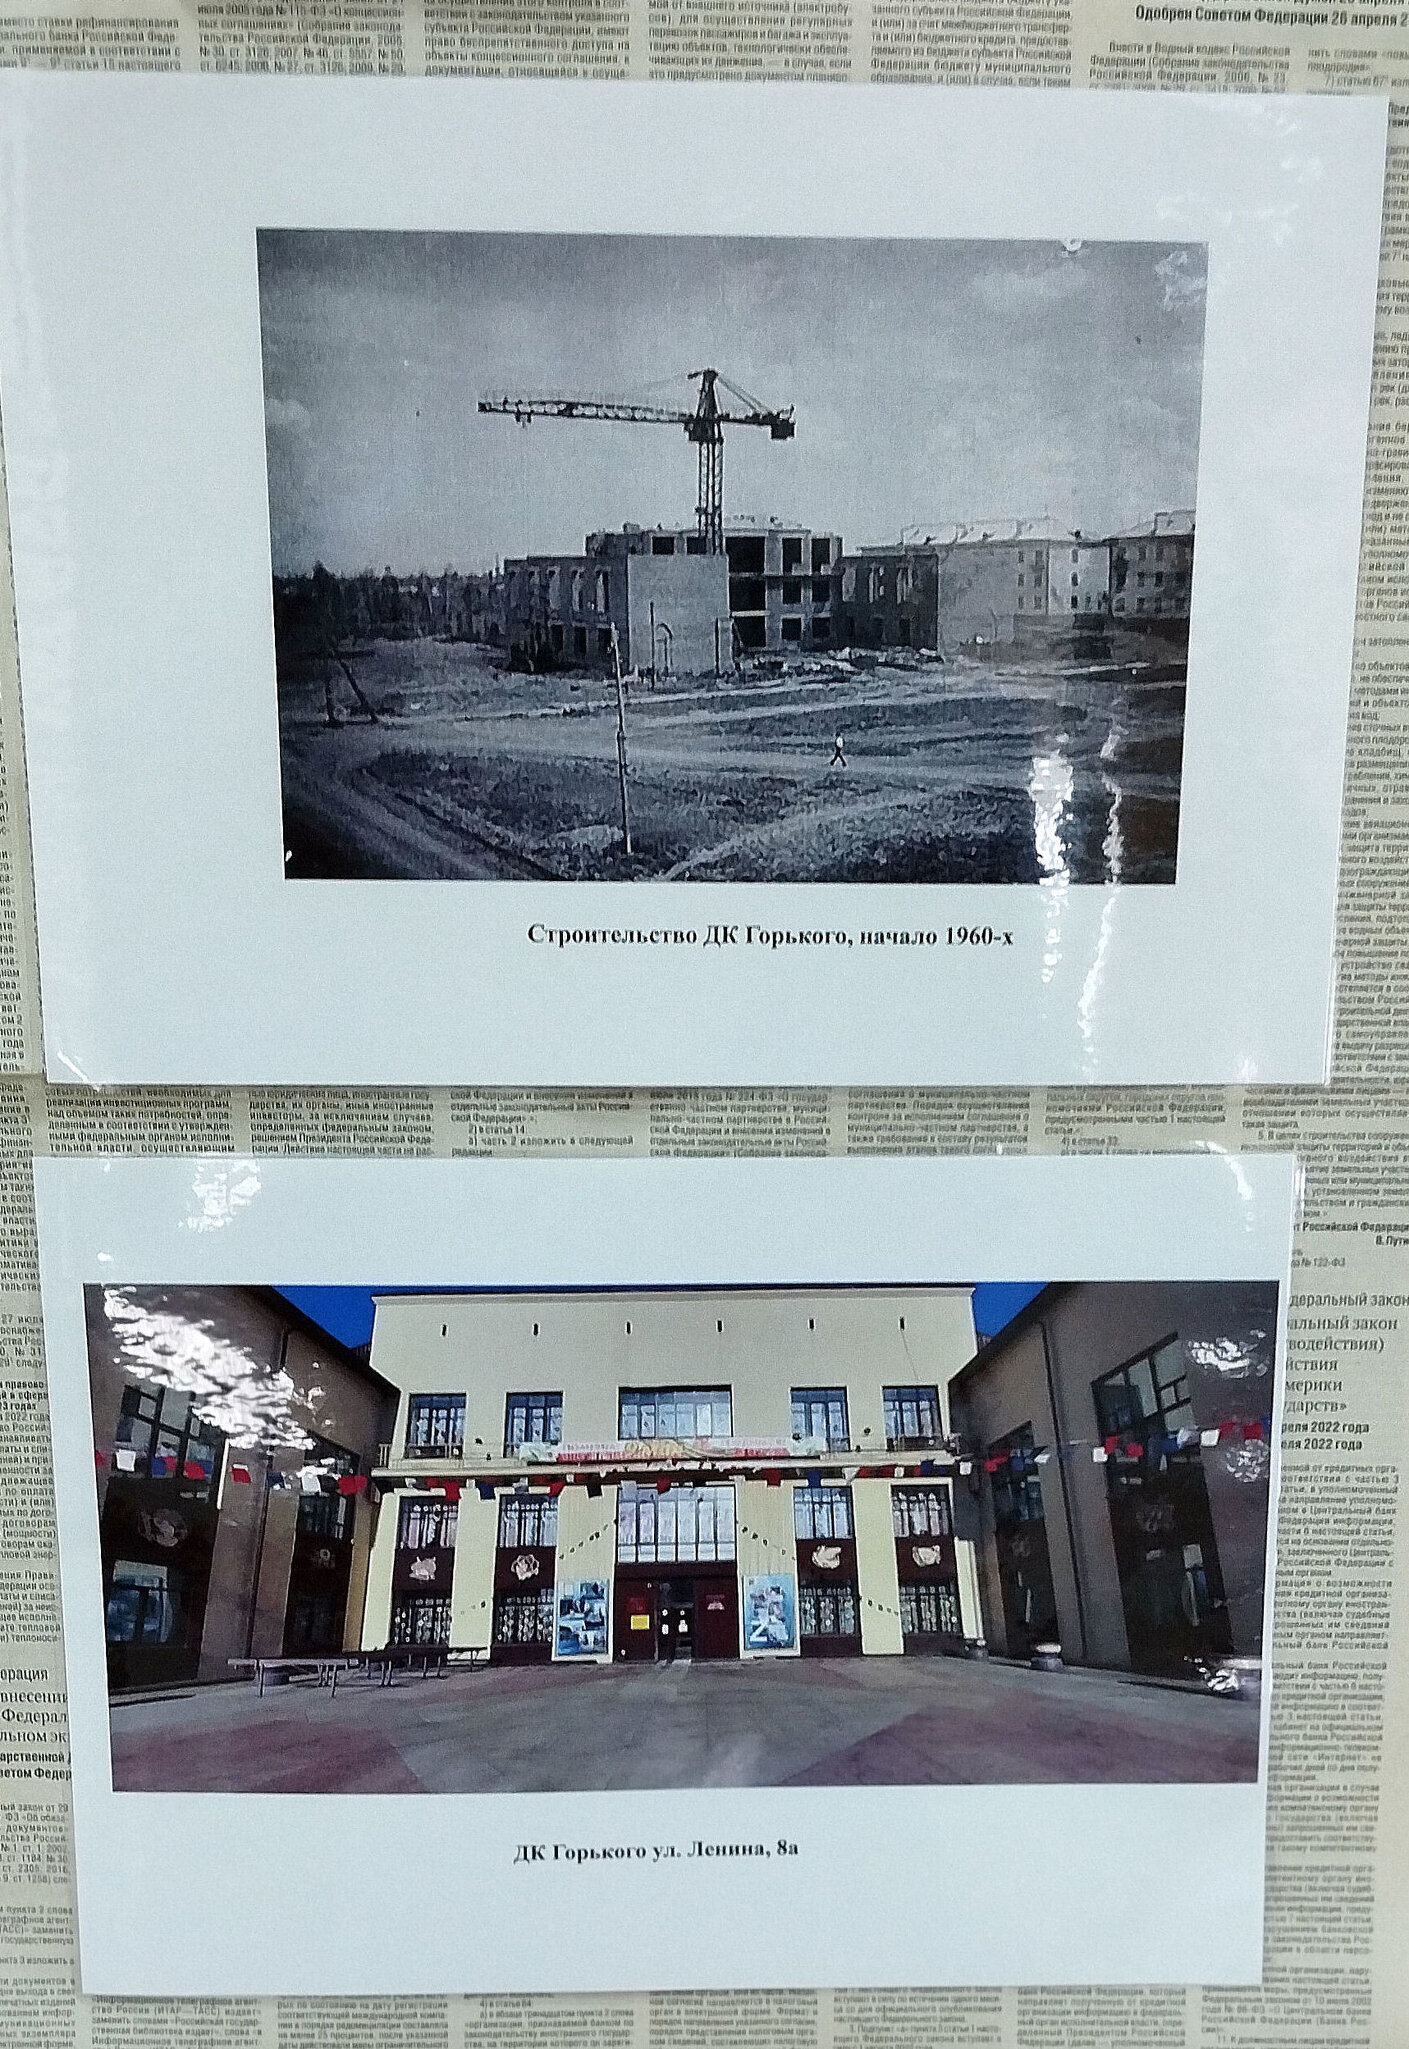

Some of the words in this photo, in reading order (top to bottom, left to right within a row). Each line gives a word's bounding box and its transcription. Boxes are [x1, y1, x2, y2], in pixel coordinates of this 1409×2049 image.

[1135, 6, 1192, 24] Одобрен
[1195, 7, 1251, 22] Советом
[1254, 9, 1328, 27] Федерации
[1331, 10, 1347, 24] 26
[1351, 14, 1397, 28] апреля
[527, 923, 697, 949] Строительство
[702, 925, 739, 949] ДК
[746, 925, 854, 950] Горького,
[860, 930, 938, 946] начало
[946, 926, 1014, 946] 1960-х
[1289, 1292, 1367, 1309] деральный
[1370, 1295, 1409, 1306] закон
[1352, 1319, 1398, 1330] закон
[1288, 1336, 1386, 1353] водействия)
[1310, 1419, 1340, 1433] 2022
[1342, 1422, 1370, 1436] года
[1304, 1436, 1333, 1450] 2022
[1335, 1439, 1364, 1453] года
[2, 1709, 68, 1726] Федерал
[513, 1844, 546, 1865] ДК
[553, 1843, 647, 1865] Горького
[652, 1845, 682, 1863] ул.
[687, 1841, 771, 1858] Ленина,
[776, 1839, 799, 1856] 8а
